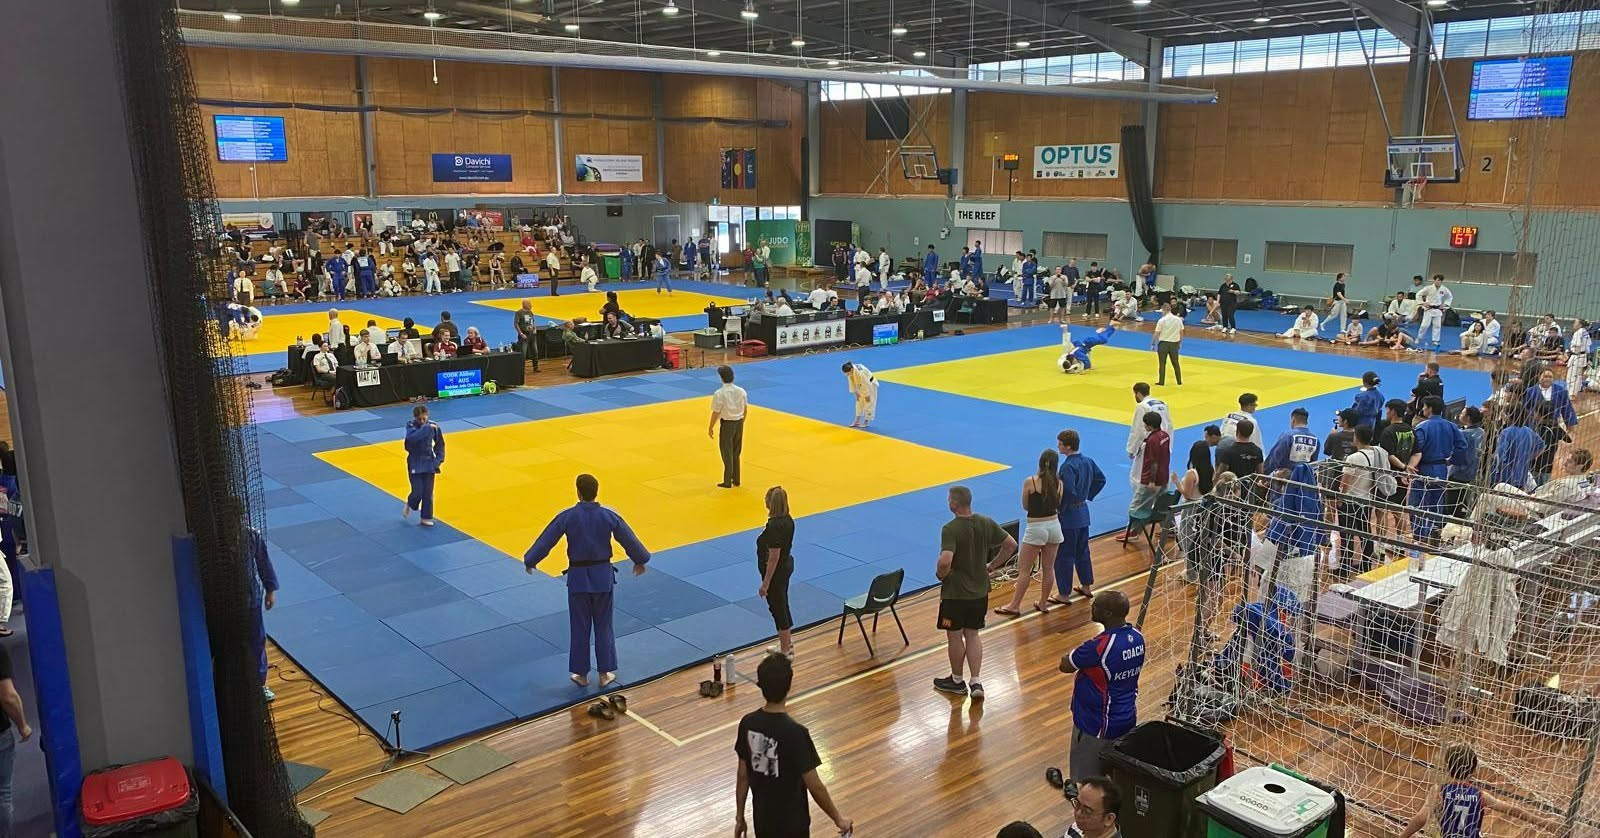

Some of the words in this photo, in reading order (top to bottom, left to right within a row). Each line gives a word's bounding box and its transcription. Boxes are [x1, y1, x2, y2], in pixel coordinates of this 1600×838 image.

[1041, 145, 1112, 165] OPTUS
[465, 157, 491, 166] Davichi
[1481, 157, 1492, 172] 2
[958, 210, 973, 220] THE
[975, 212, 996, 220] REEF
[769, 236, 788, 244] JUDO
[1455, 234, 1472, 246] 67
[358, 372, 370, 382] MAT
[1122, 644, 1144, 660] COACH
[1454, 804, 1470, 830] 7
